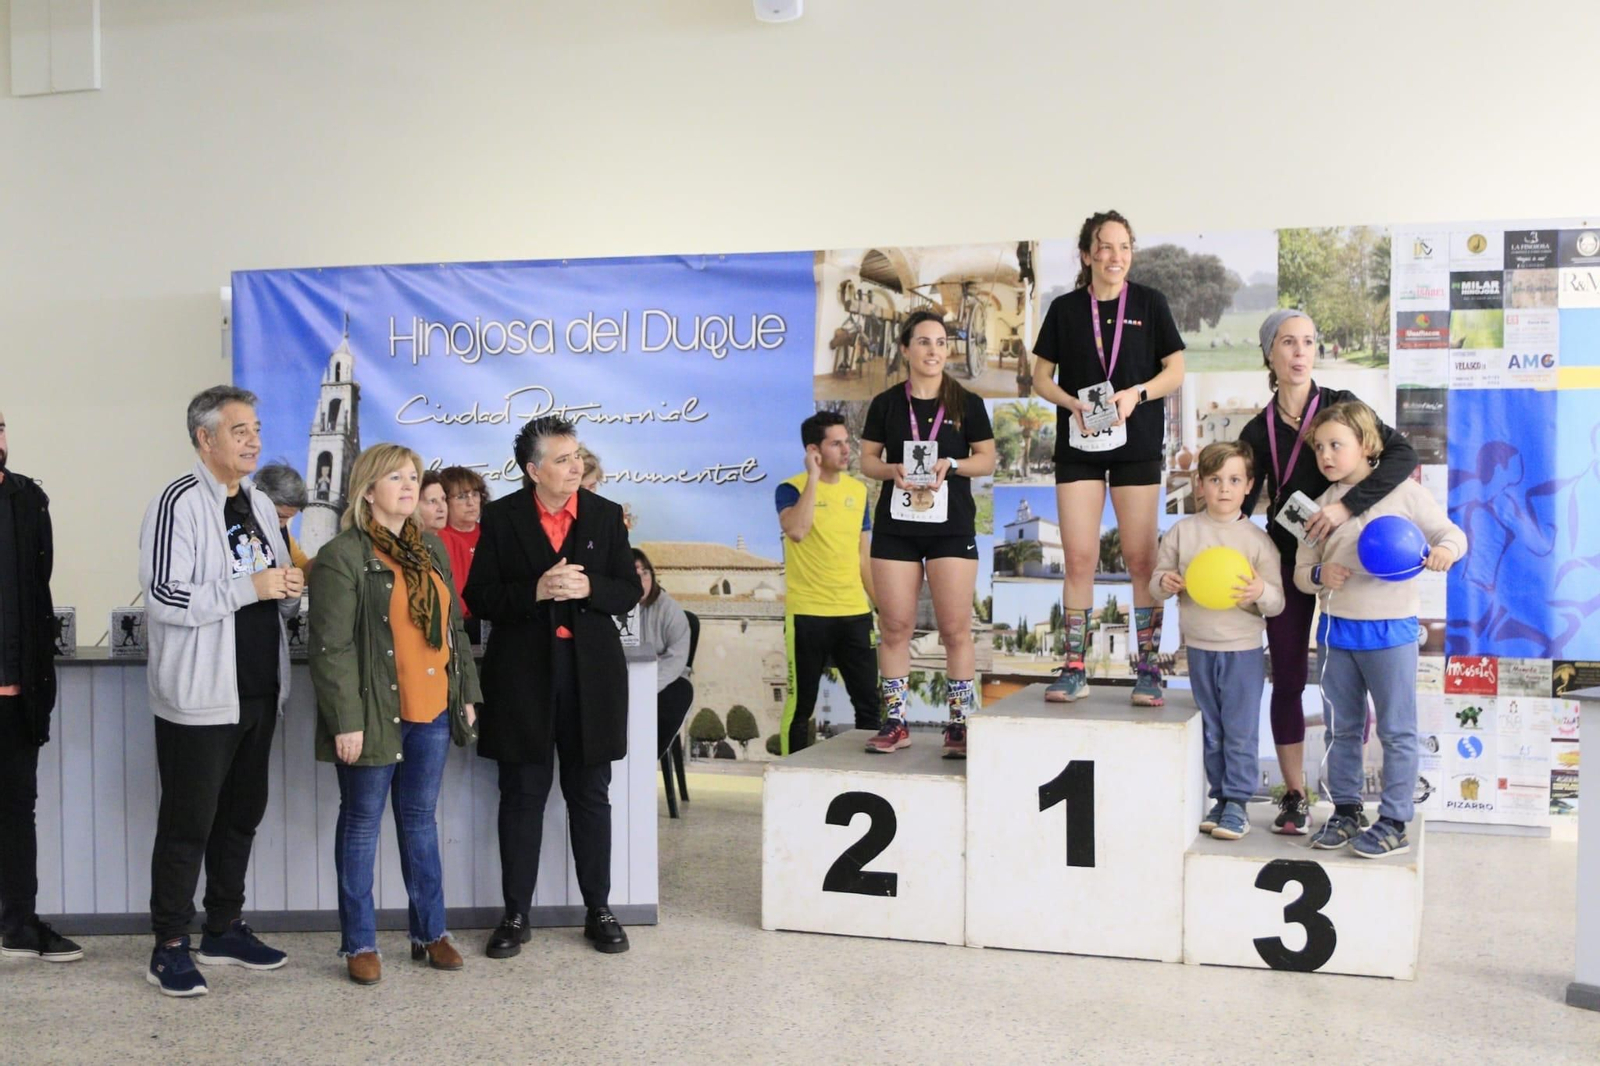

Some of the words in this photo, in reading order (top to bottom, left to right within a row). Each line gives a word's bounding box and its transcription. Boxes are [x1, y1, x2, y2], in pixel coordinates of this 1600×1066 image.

[1461, 280, 1500, 290] MILAR
[388, 314, 555, 364] Hinojosa
[566, 310, 628, 354] del
[394, 393, 512, 425] Ciudad
[1038, 760, 1096, 868] 1
[1447, 800, 1494, 812] PIZARRO
[822, 790, 899, 898] 2
[1252, 858, 1338, 973] 3
